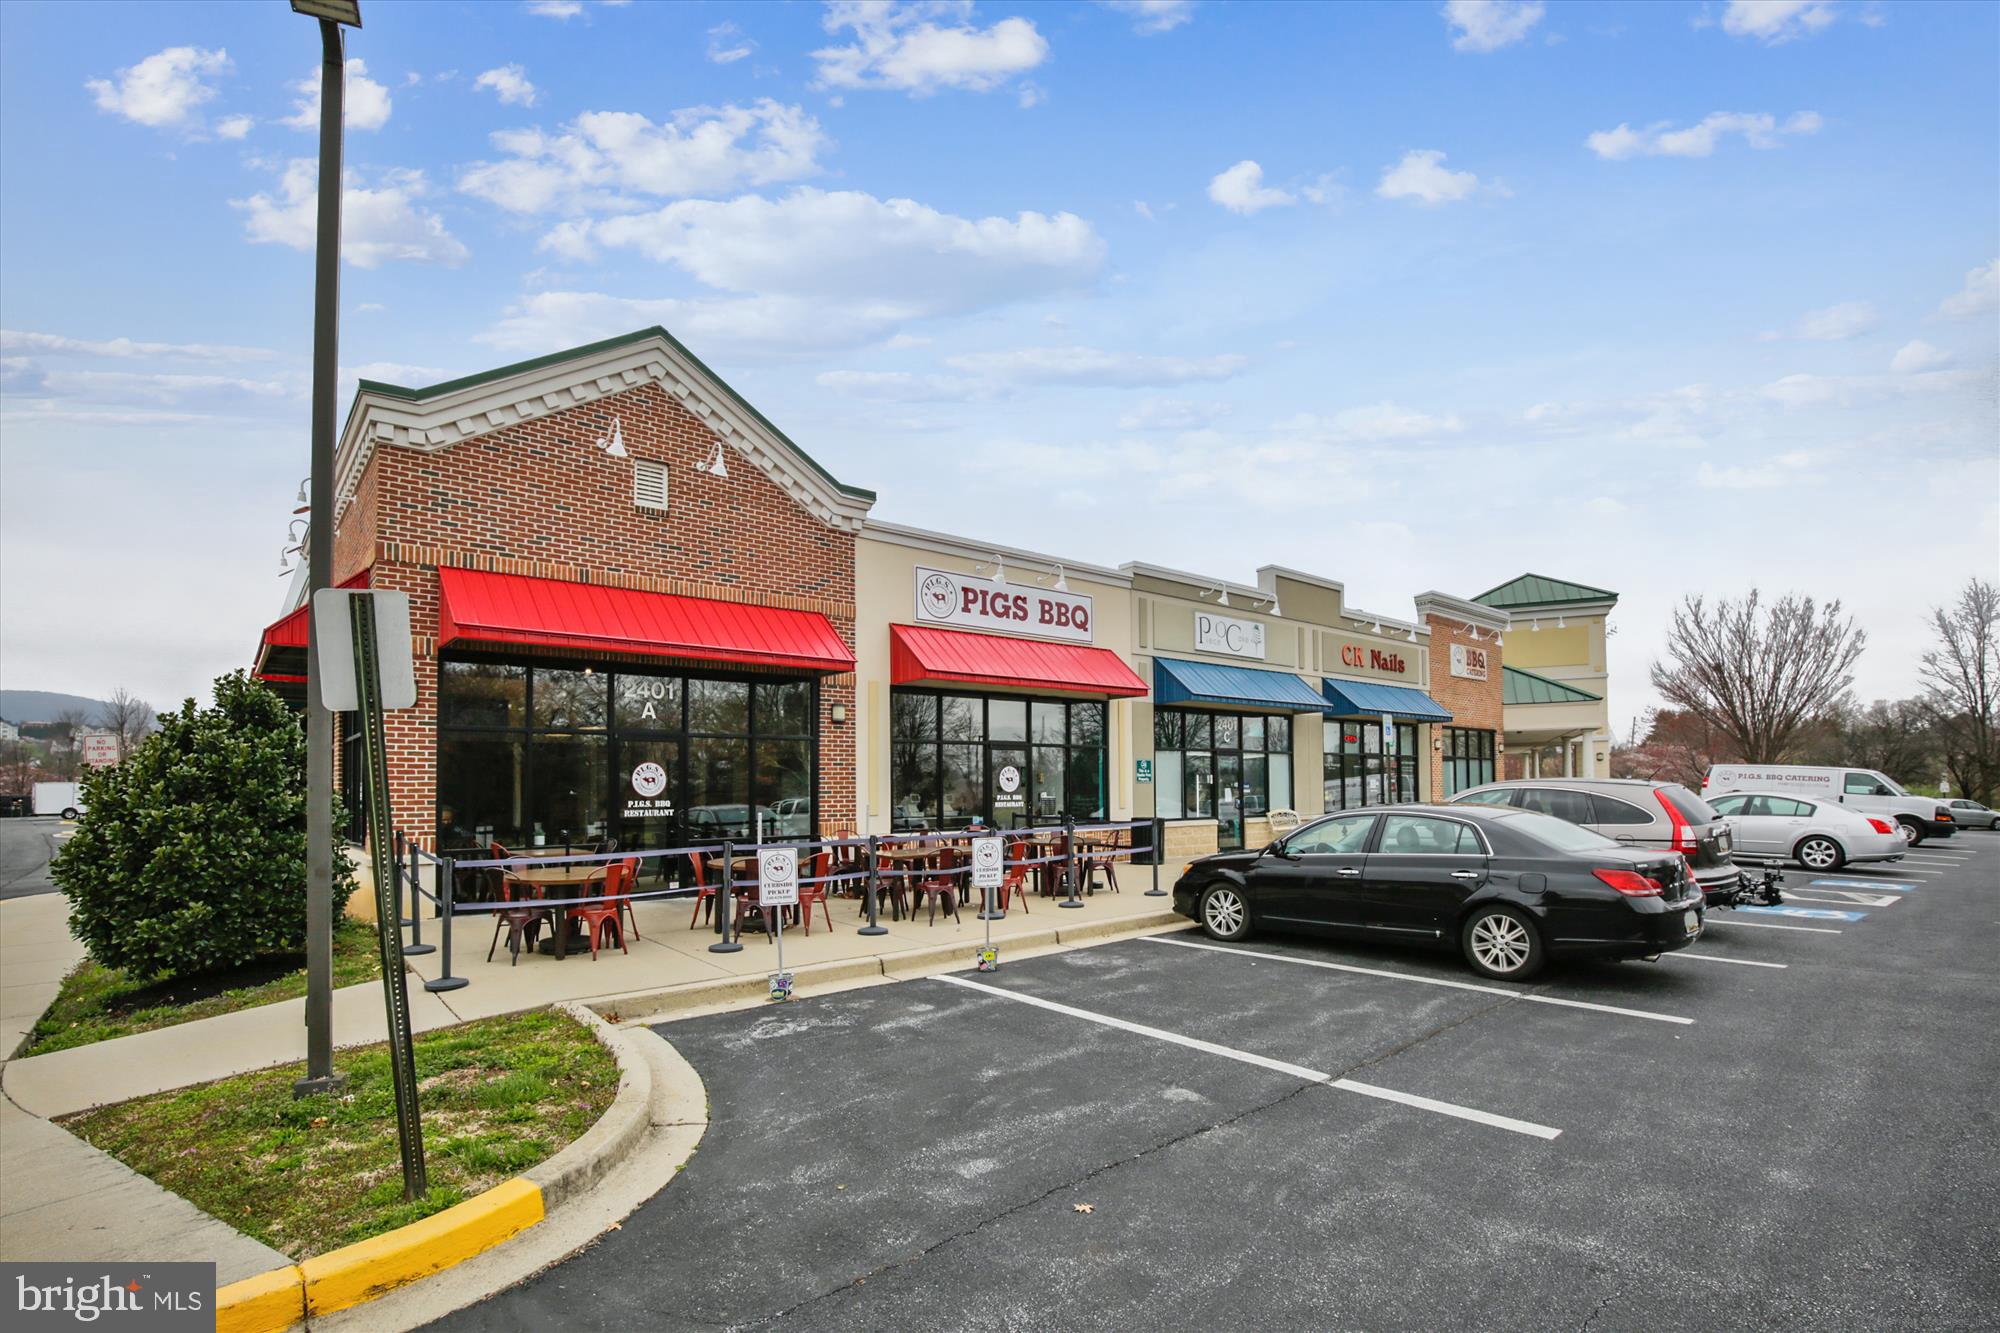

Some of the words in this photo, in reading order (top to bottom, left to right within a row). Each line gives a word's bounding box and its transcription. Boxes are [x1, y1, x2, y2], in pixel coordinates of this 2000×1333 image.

[961, 586, 1029, 622] PIGS
[1038, 598, 1089, 632] BBQ
[1342, 644, 1364, 668] CK
[1370, 648, 1405, 673] Nails
[1466, 650, 1485, 669] BBQ
[624, 681, 674, 700] 2401
[641, 702, 657, 719] A
[1224, 731, 1231, 743] C
[1784, 774, 1831, 783] CATERING
[654, 800, 671, 808] BBQ
[624, 809, 675, 817] RESTAURANT
